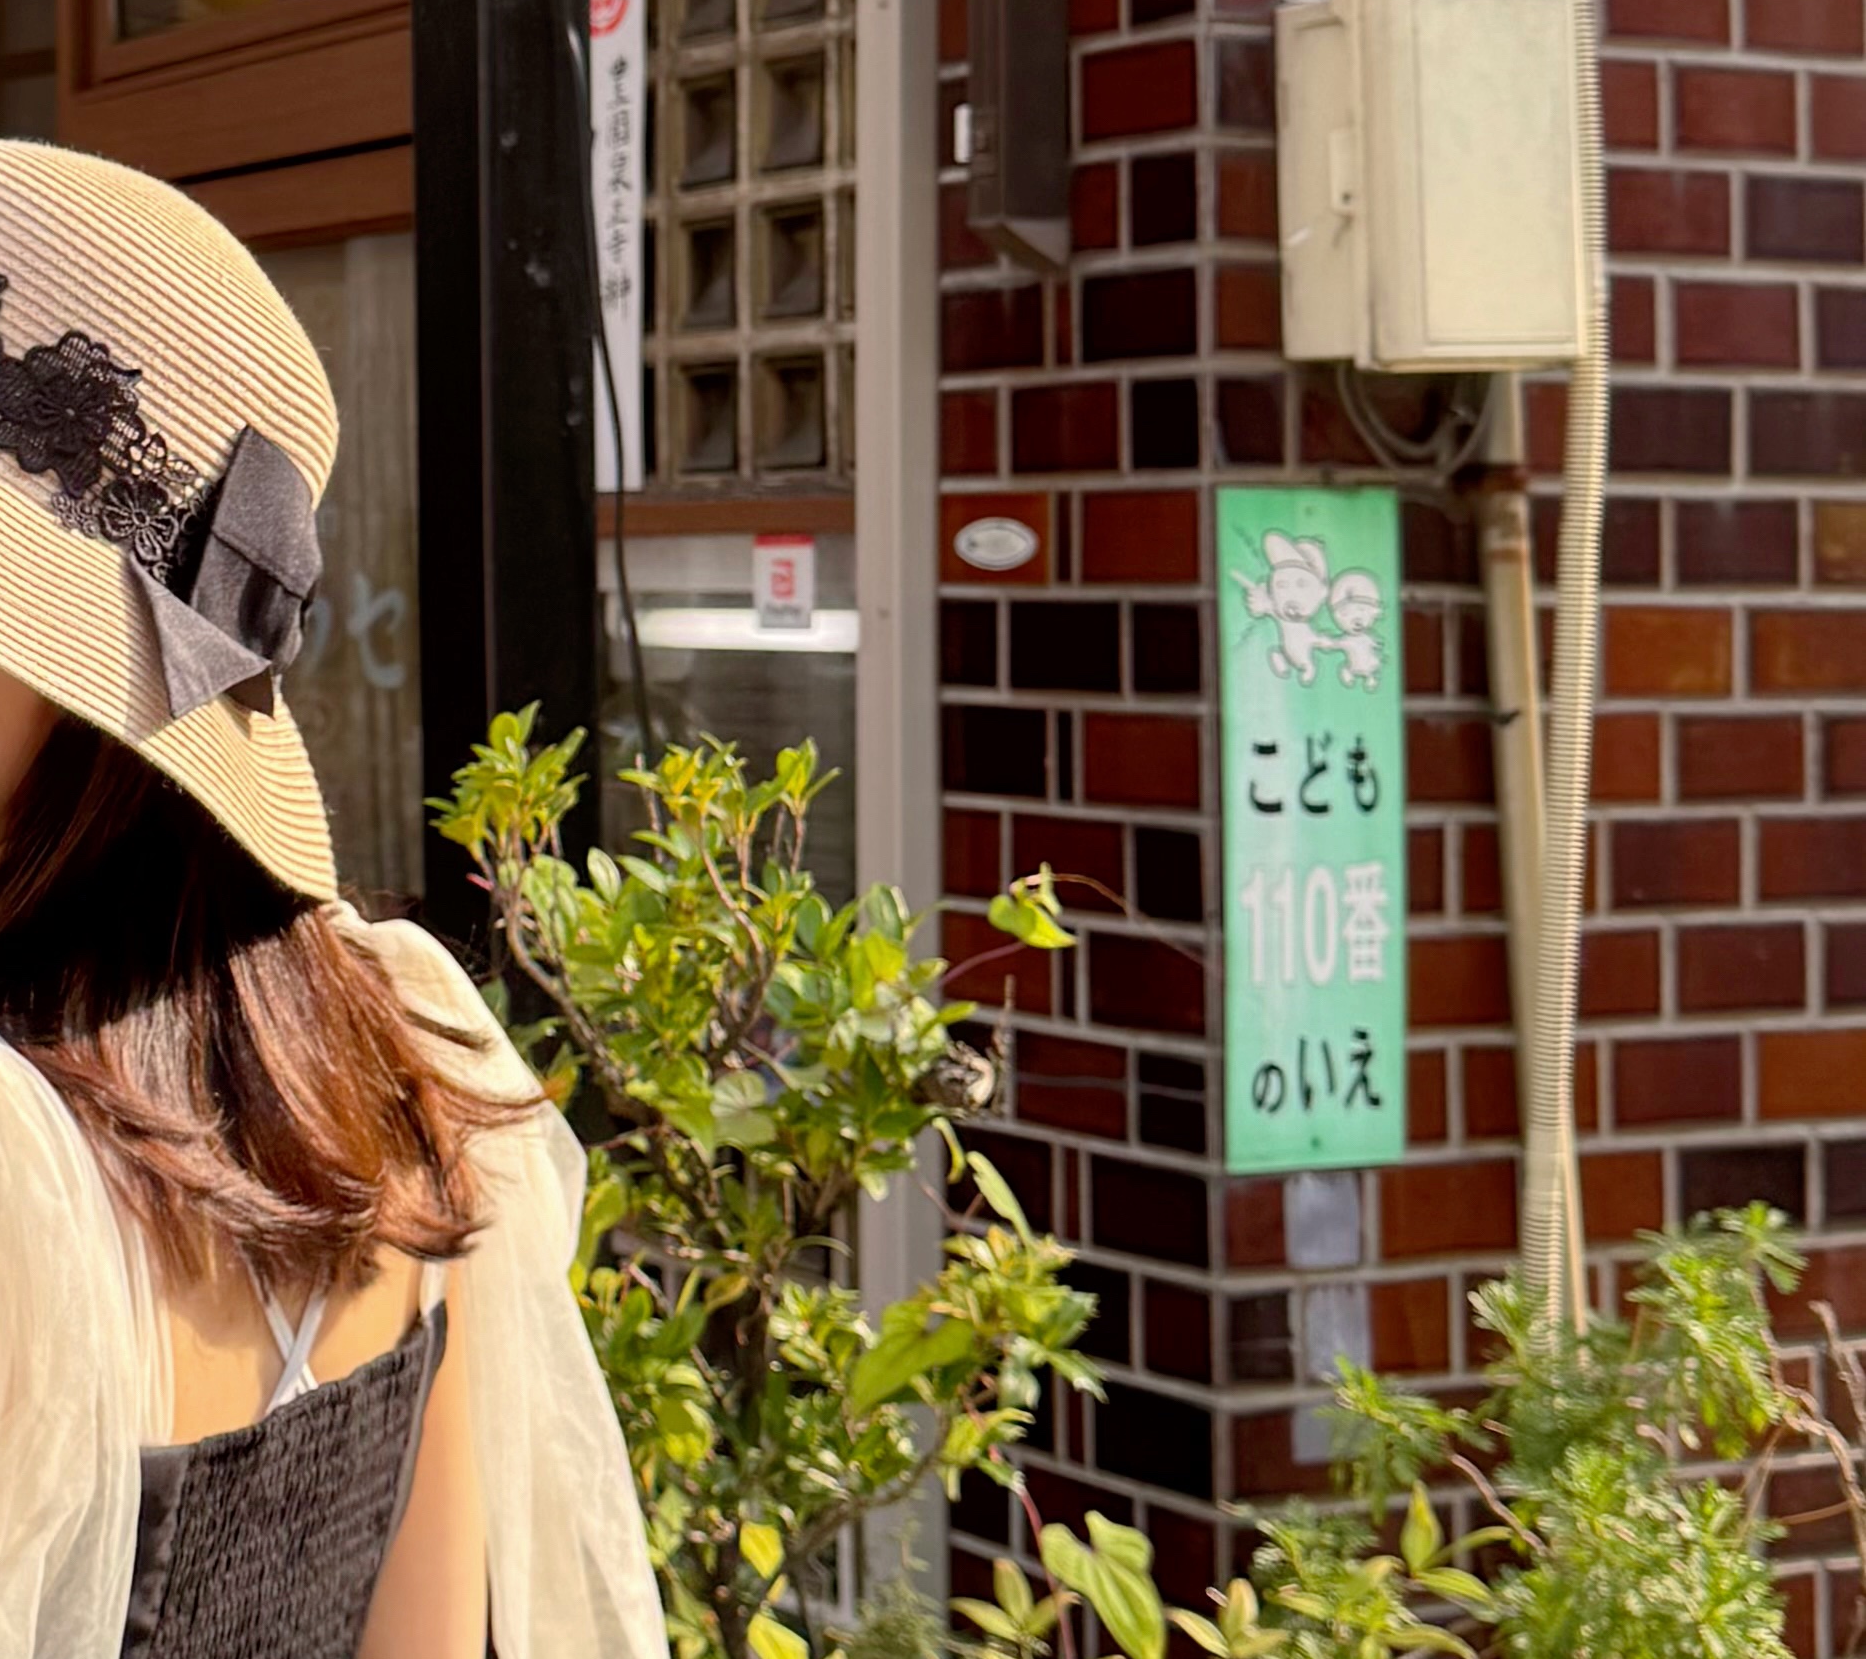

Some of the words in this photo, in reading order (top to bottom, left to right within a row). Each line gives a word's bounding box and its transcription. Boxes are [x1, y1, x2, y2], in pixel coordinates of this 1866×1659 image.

[1249, 730, 1381, 814] こども
[1241, 860, 1390, 987] 110番
[1251, 1027, 1383, 1114] のいえ
